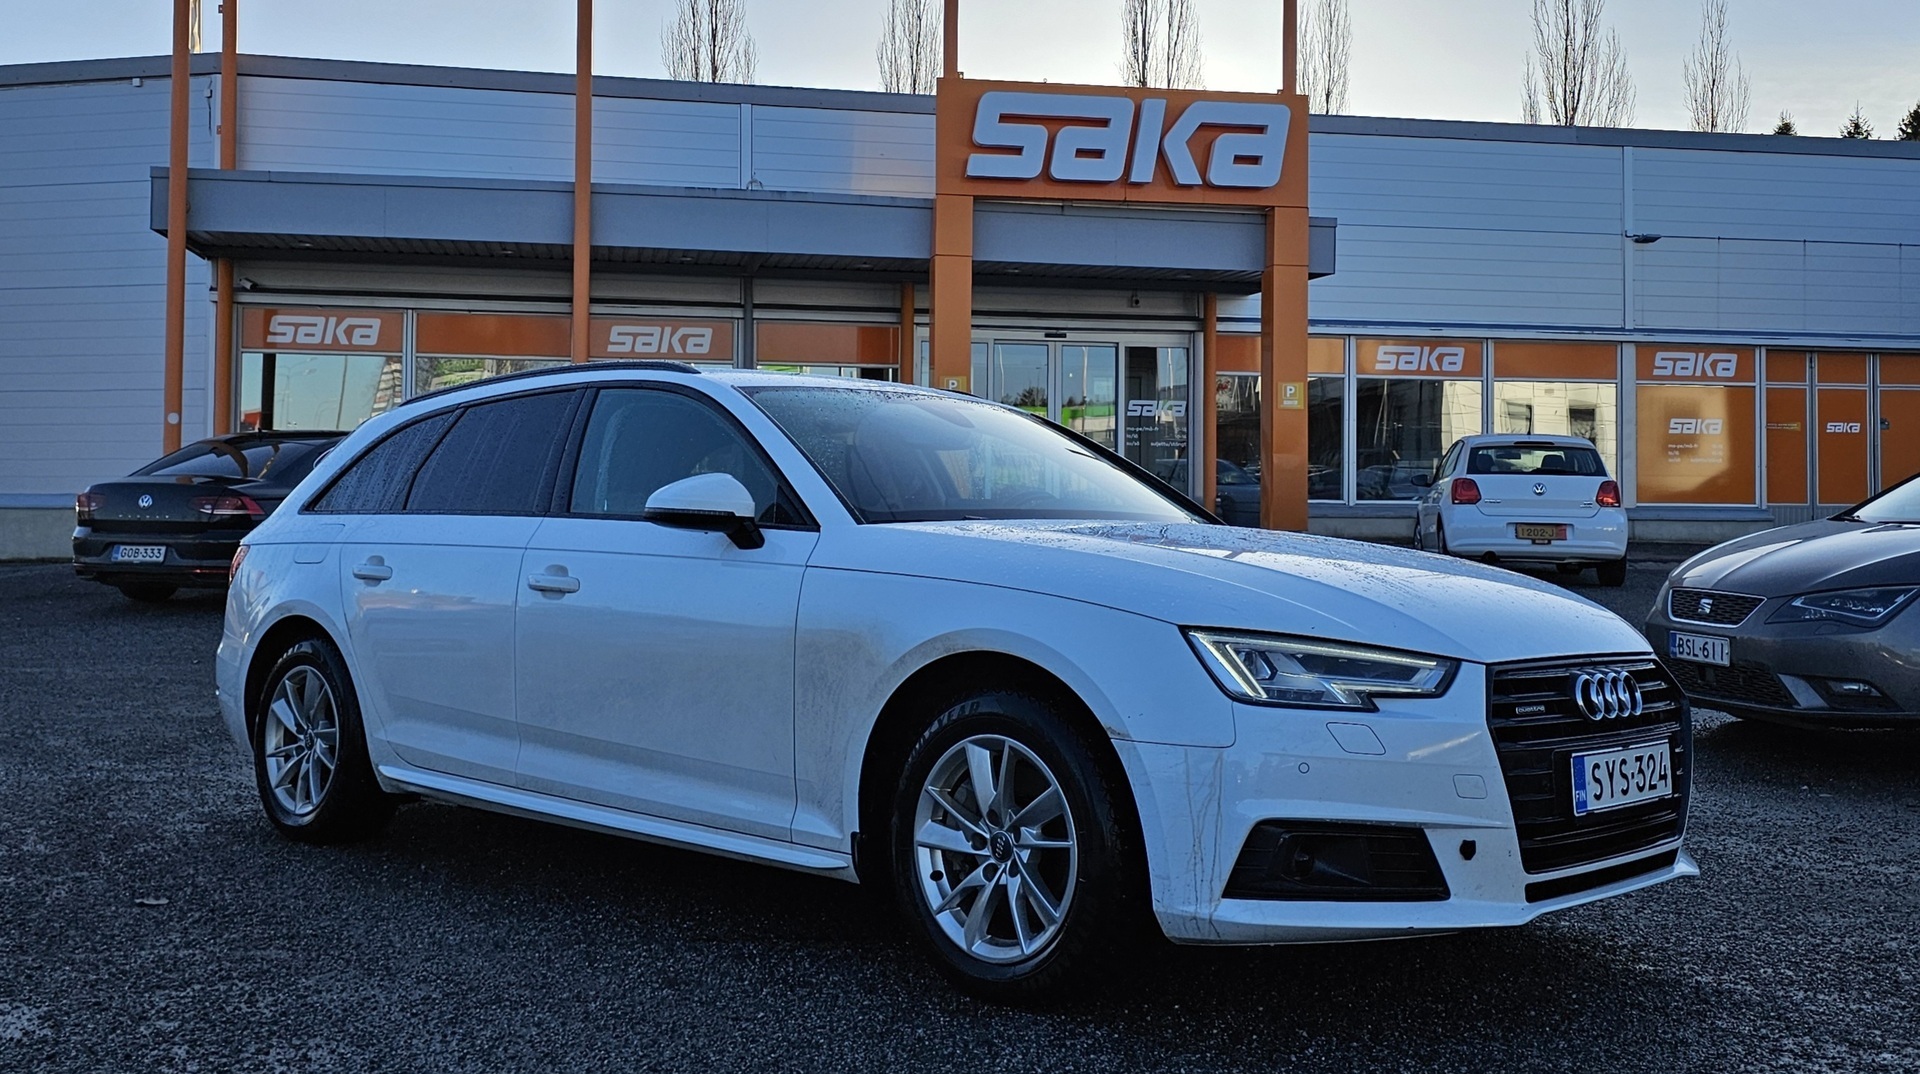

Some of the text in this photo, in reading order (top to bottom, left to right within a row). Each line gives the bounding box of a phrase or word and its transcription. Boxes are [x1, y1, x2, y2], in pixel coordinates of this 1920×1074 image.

[120, 547, 162, 559] GOB-333
[1677, 637, 1724, 662] BSL-611
[1591, 750, 1669, 801] SYS-324
[1575, 789, 1587, 803] FIN
